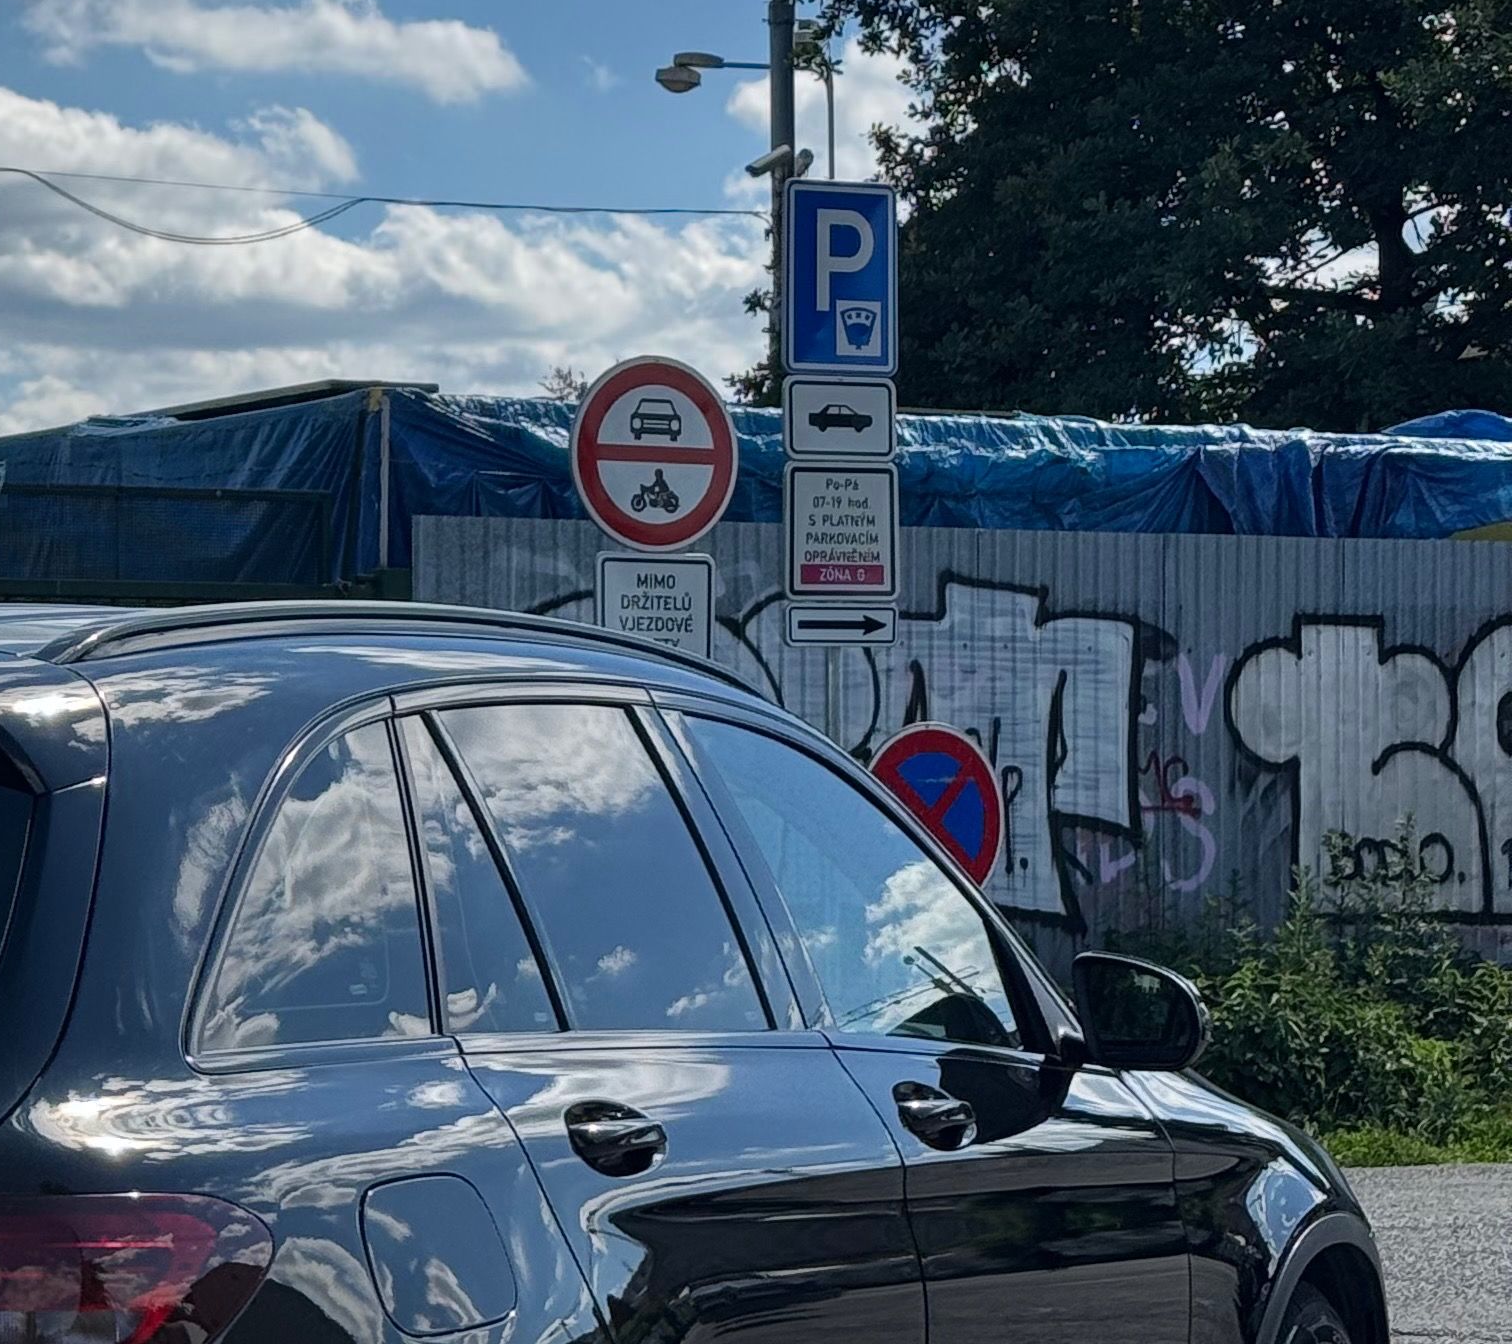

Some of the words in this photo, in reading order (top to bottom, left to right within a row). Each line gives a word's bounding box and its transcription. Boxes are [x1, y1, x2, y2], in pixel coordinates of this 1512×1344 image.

[816, 207, 875, 312] P
[813, 496, 842, 509] 07-19
[808, 514, 817, 526] S
[822, 511, 876, 527] PLATNÝM
[805, 530, 879, 545] PARKOVACÍM
[804, 548, 880, 563] OPRÁVNĚNÍM
[636, 573, 676, 589] MIMO
[819, 566, 852, 581] ZÓNA
[620, 591, 692, 611] DRŽITELŮ
[618, 614, 693, 633] VJEZDOVÉ
